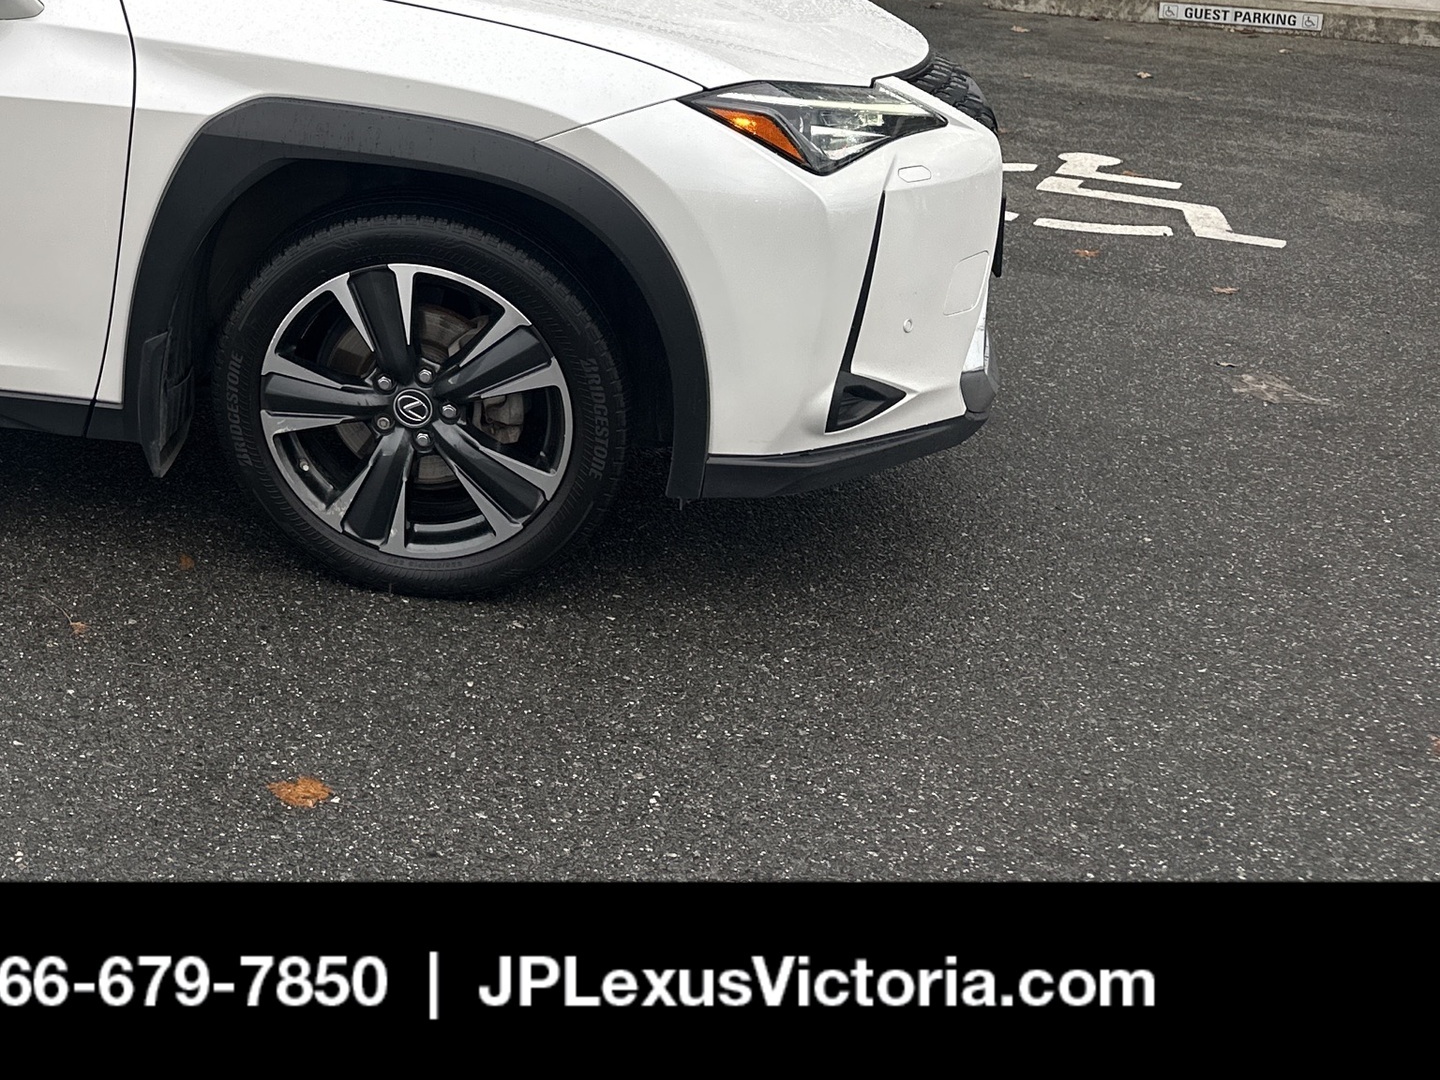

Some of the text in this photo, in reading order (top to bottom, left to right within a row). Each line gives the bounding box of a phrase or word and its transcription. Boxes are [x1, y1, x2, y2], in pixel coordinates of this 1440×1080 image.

[1184, 7, 1297, 26] GUEST PARKING
[225, 349, 254, 467] BRIDGESTONE
[578, 358, 610, 481] BRIDGESTONE
